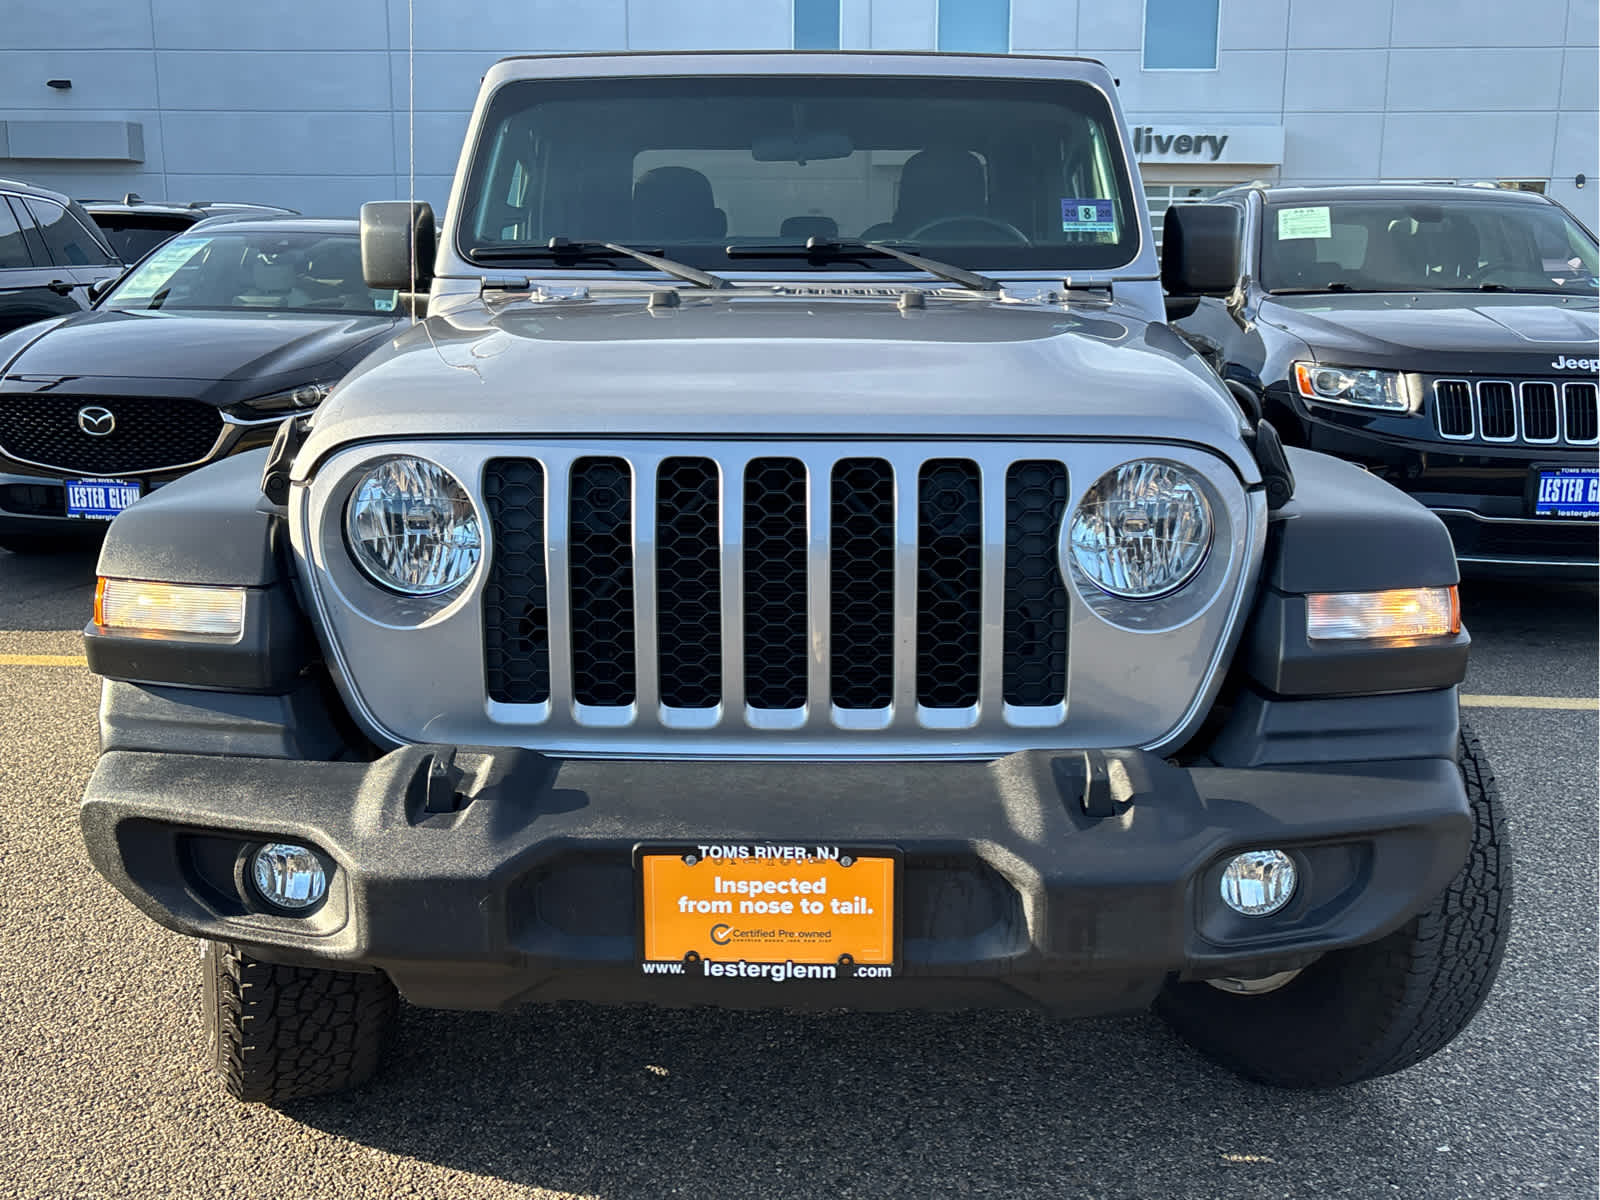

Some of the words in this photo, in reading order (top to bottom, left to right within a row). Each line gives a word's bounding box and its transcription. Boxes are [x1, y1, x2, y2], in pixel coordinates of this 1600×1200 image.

[1083, 207, 1092, 220] 8
[1551, 355, 1599, 372] Jeep
[69, 487, 106, 508] LESTER
[108, 487, 140, 508] GLENN
[1538, 478, 1584, 502] LESTER
[698, 845, 749, 859] TOMS
[754, 845, 811, 860] RIVER,
[816, 846, 839, 860] NJ
[714, 876, 826, 898] Inspected
[677, 895, 732, 914] from
[740, 899, 794, 914] nose
[800, 898, 824, 914] to
[830, 896, 874, 915] tail.
[733, 929, 775, 938] Certified
[642, 962, 685, 974] www.
[703, 959, 836, 981] lesterglenn
[853, 965, 892, 978] .com
